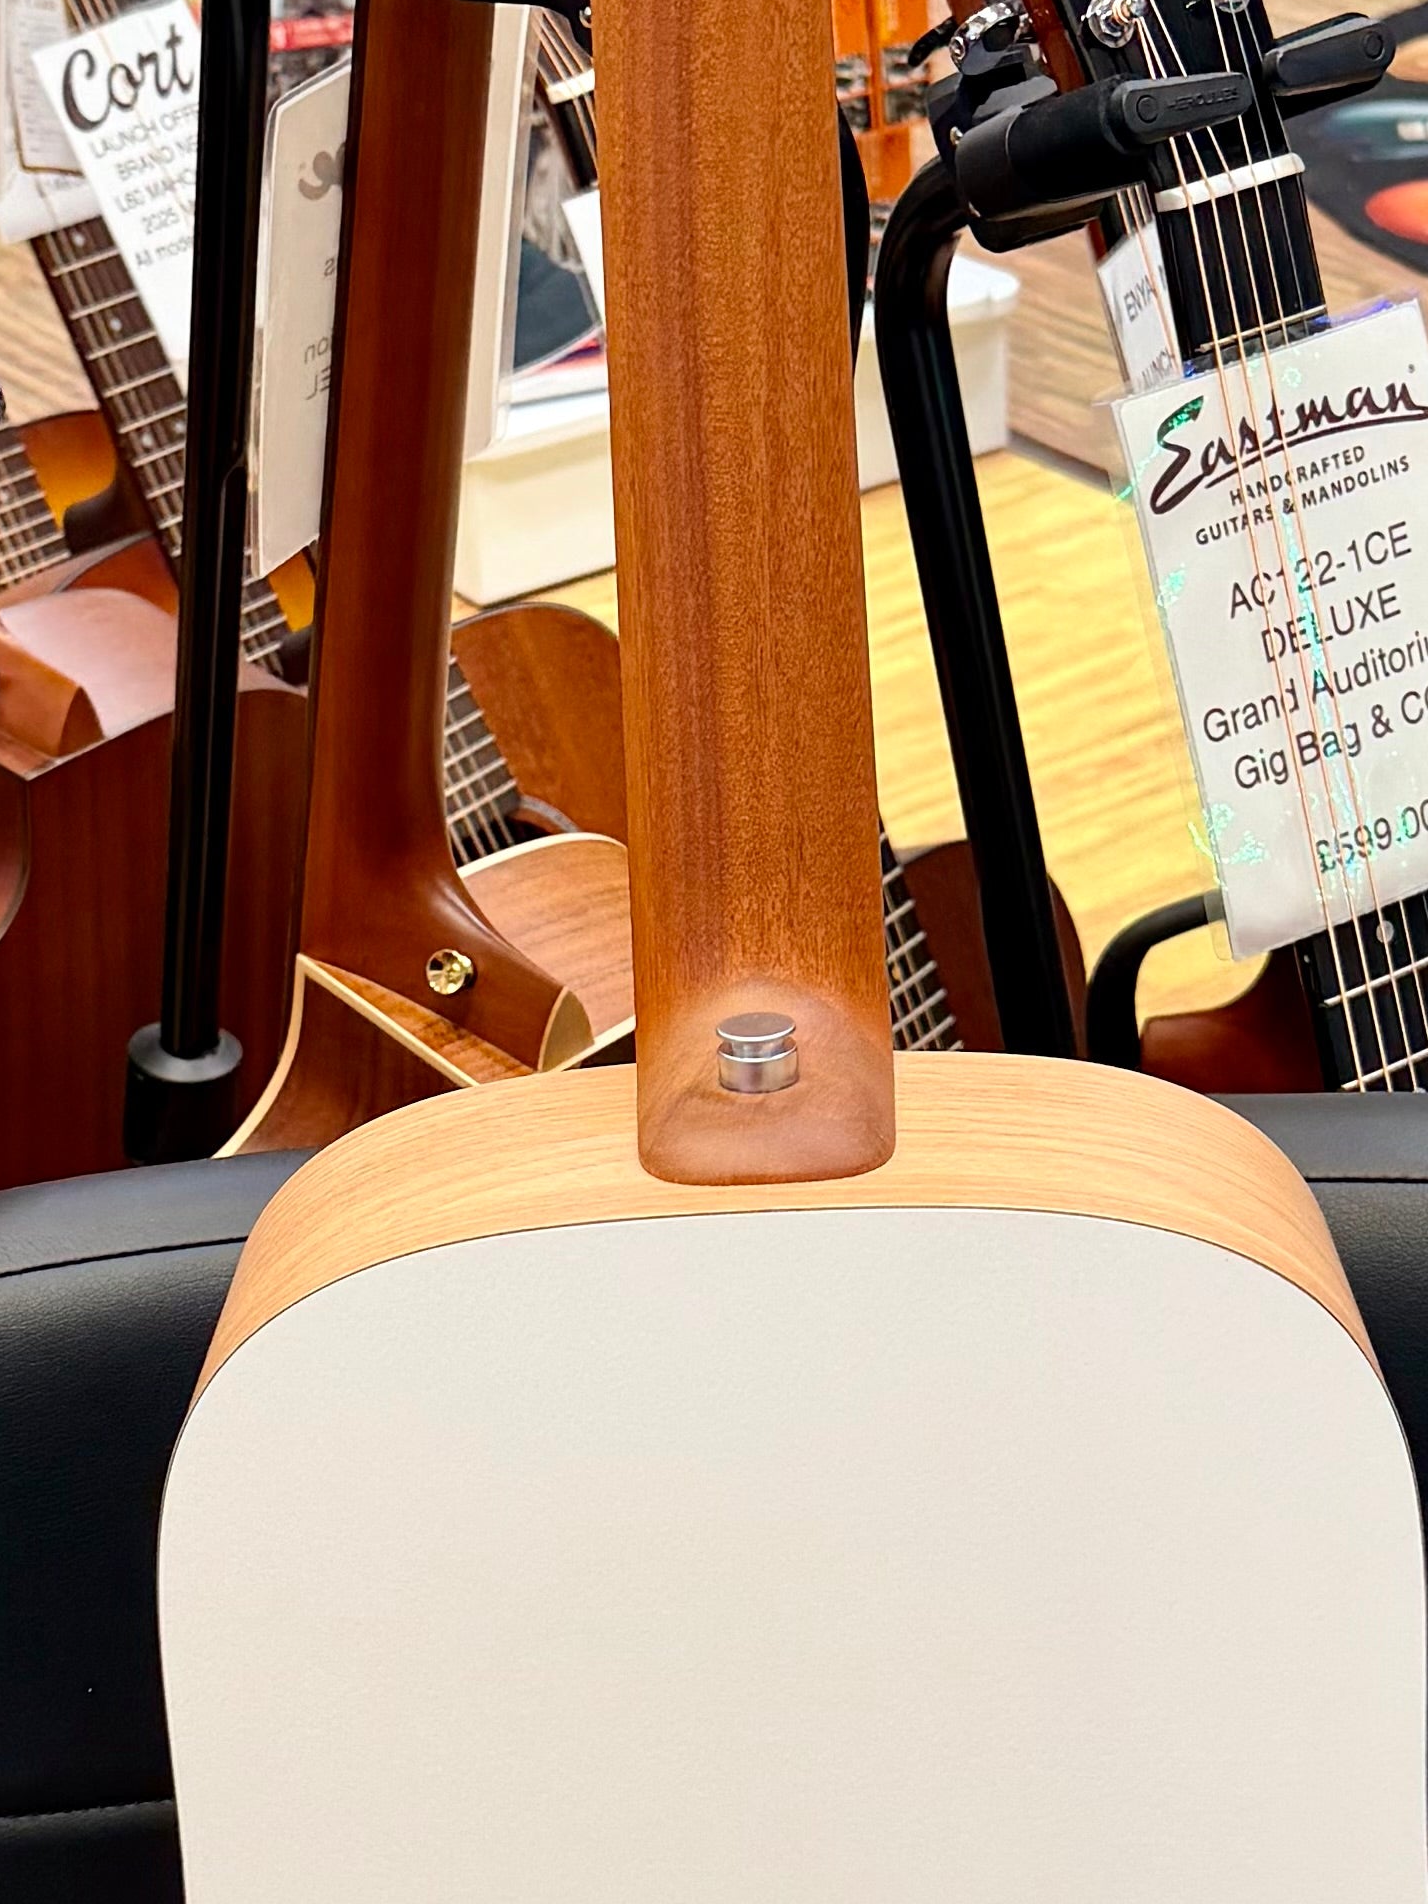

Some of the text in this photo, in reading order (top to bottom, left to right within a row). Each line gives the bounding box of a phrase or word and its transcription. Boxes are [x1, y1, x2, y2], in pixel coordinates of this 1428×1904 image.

[62, 23, 195, 133] Cort
[88, 102, 199, 159] LAUNCH OFFE
[115, 145, 175, 181] BRAND
[1195, 455, 1410, 547] GUITARS & MANDOLINS
[1228, 445, 1366, 508] HANDCRAFTED
[1261, 582, 1402, 664] DELUXE
[1202, 677, 1300, 743] Grand
[1233, 748, 1290, 790] Gig
[1295, 721, 1362, 766] Bag
[1372, 703, 1395, 739] &
